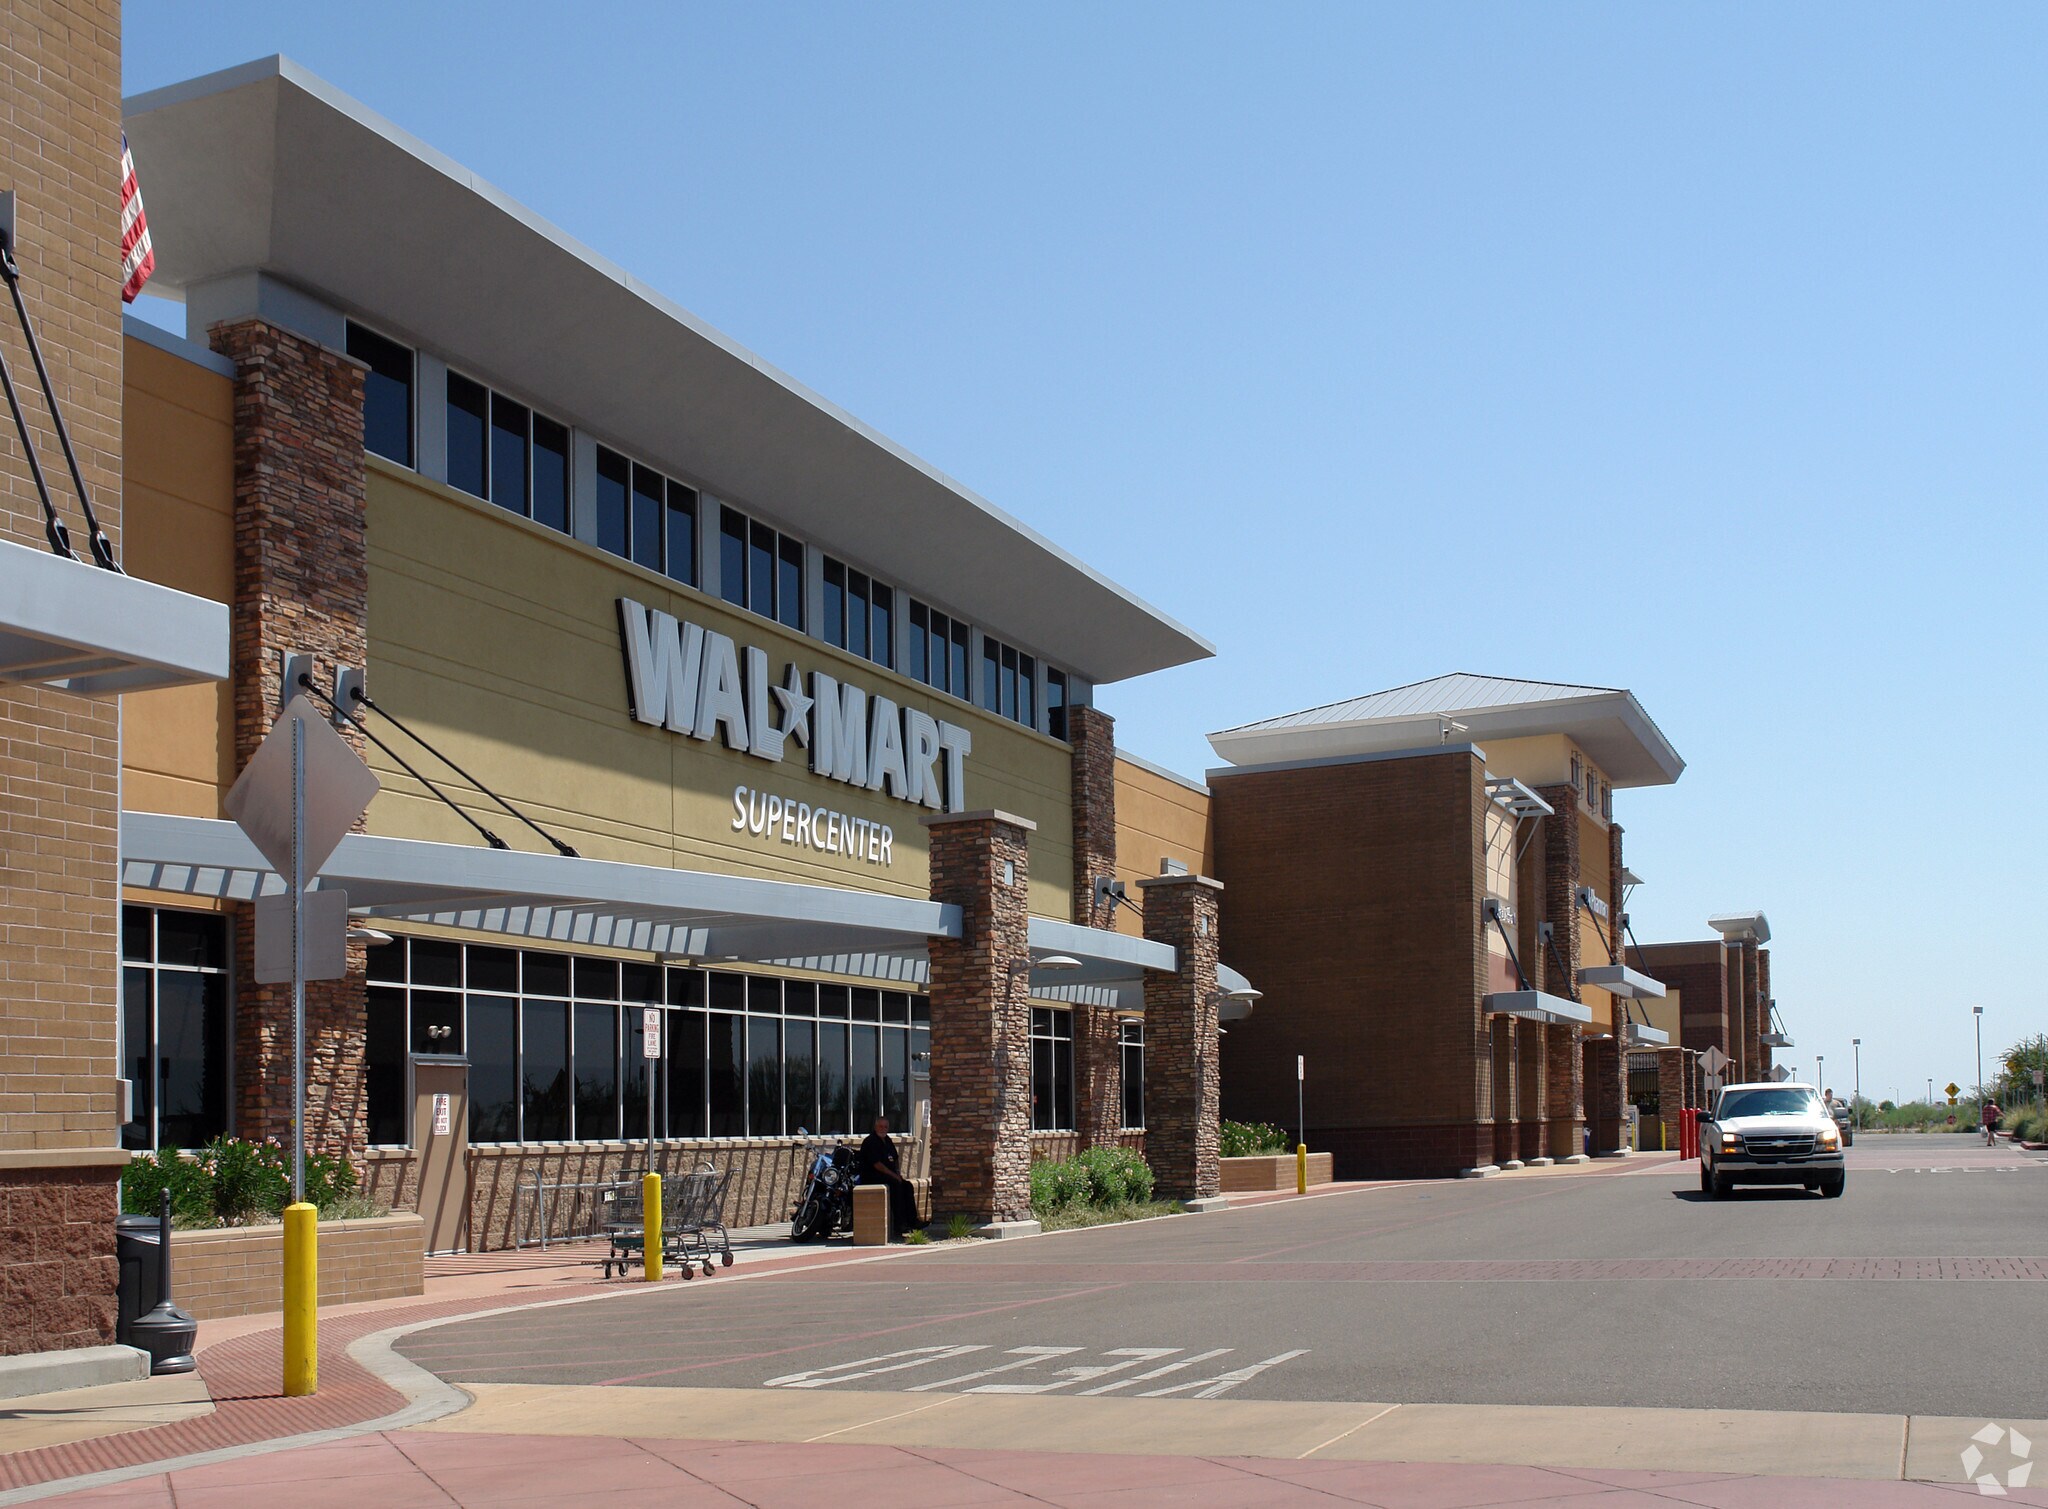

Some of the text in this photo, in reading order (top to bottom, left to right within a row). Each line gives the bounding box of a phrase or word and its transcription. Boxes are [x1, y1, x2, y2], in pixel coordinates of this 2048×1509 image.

[731, 785, 893, 865] SUPERCENTER
[649, 1012, 656, 1023] NO
[645, 1023, 659, 1033] PARKING
[436, 1097, 447, 1106] FIRE
[436, 1107, 447, 1116] EXIT
[763, 1344, 1312, 1399] YIELD
